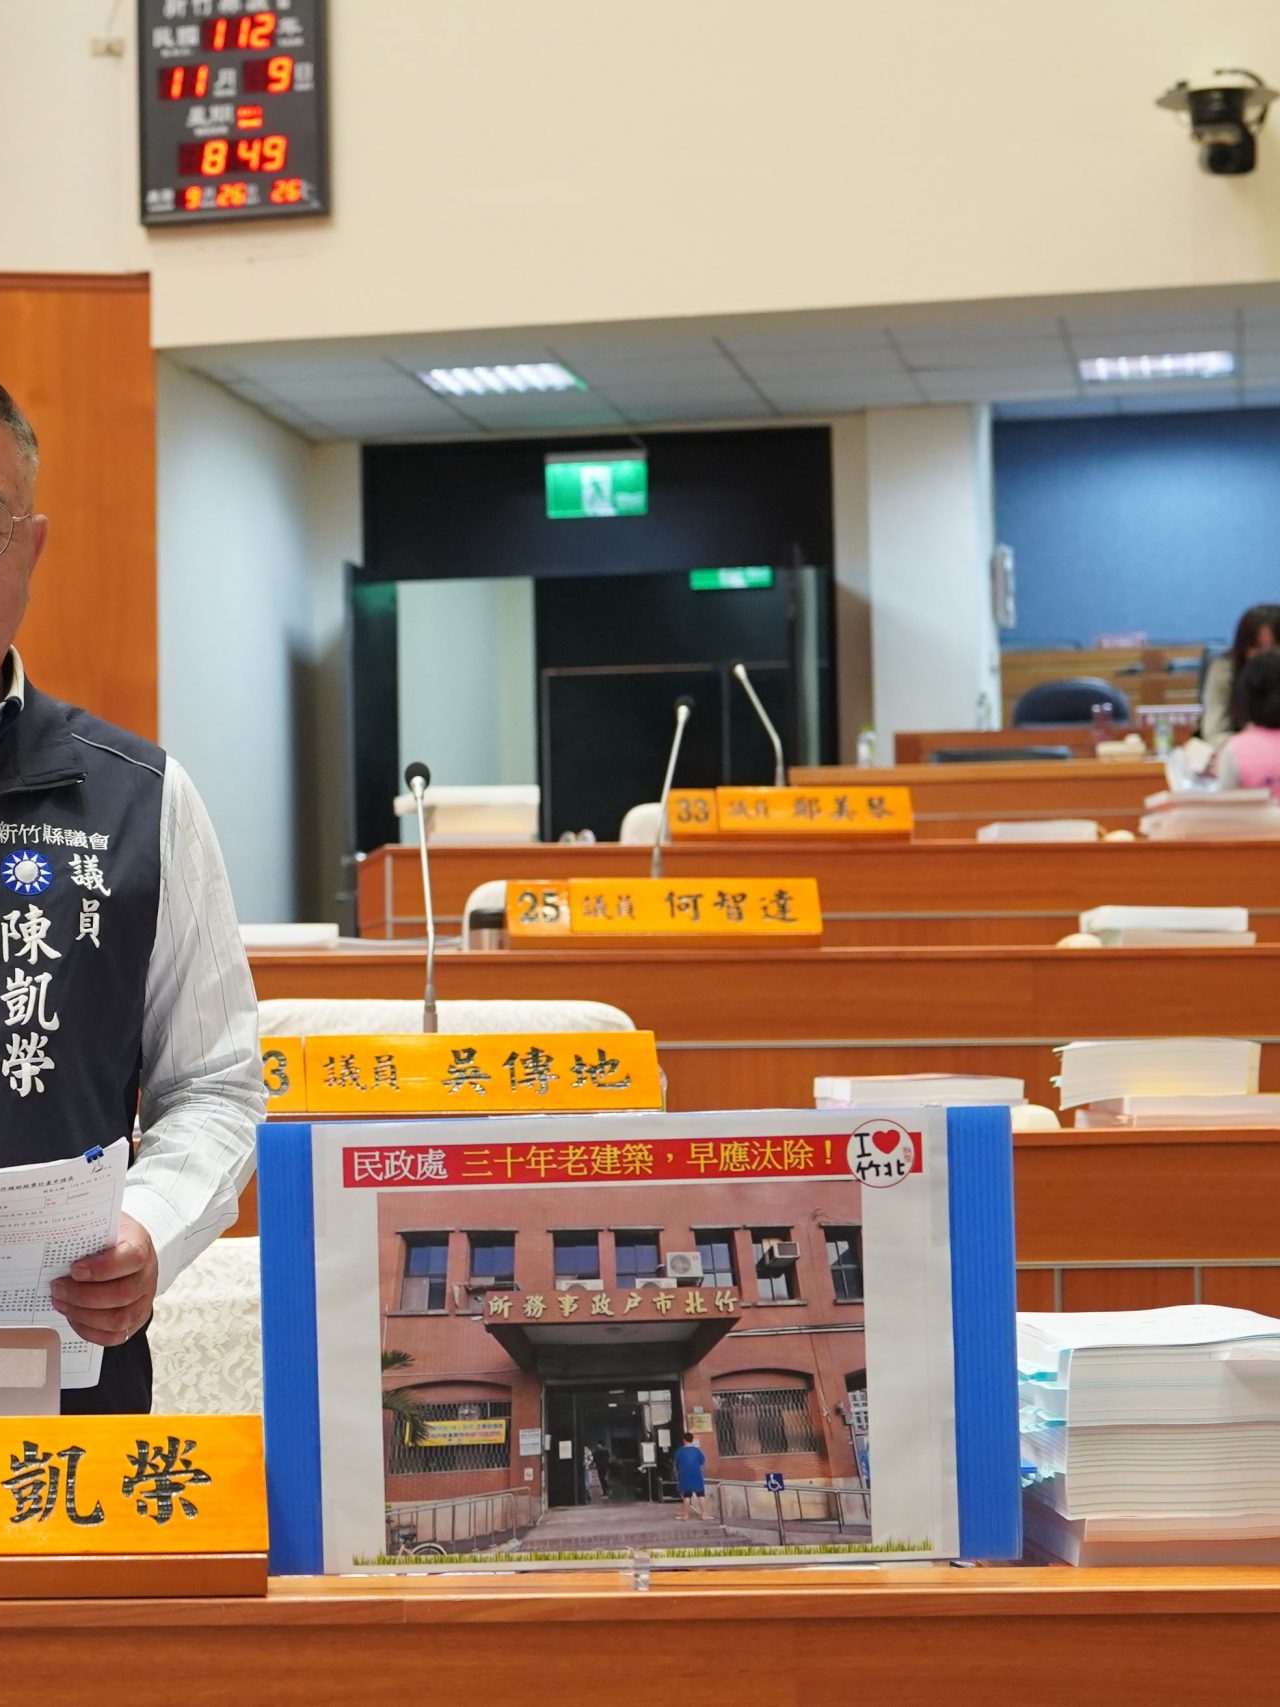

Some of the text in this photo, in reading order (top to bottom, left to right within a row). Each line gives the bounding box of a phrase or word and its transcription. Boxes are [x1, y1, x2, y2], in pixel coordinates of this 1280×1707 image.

[213, 12, 276, 51] 112
[170, 64, 209, 100] 11
[267, 55, 294, 93] 9
[201, 134, 288, 176] 8 49
[676, 796, 710, 824] 33
[68, 853, 111, 948] 議員
[518, 890, 560, 923] 25
[665, 888, 801, 922] 何智達
[0, 904, 62, 1098] 陳凱榮
[322, 1053, 402, 1091] 議員
[352, 1147, 449, 1182] 民政處
[853, 1132, 872, 1159] I
